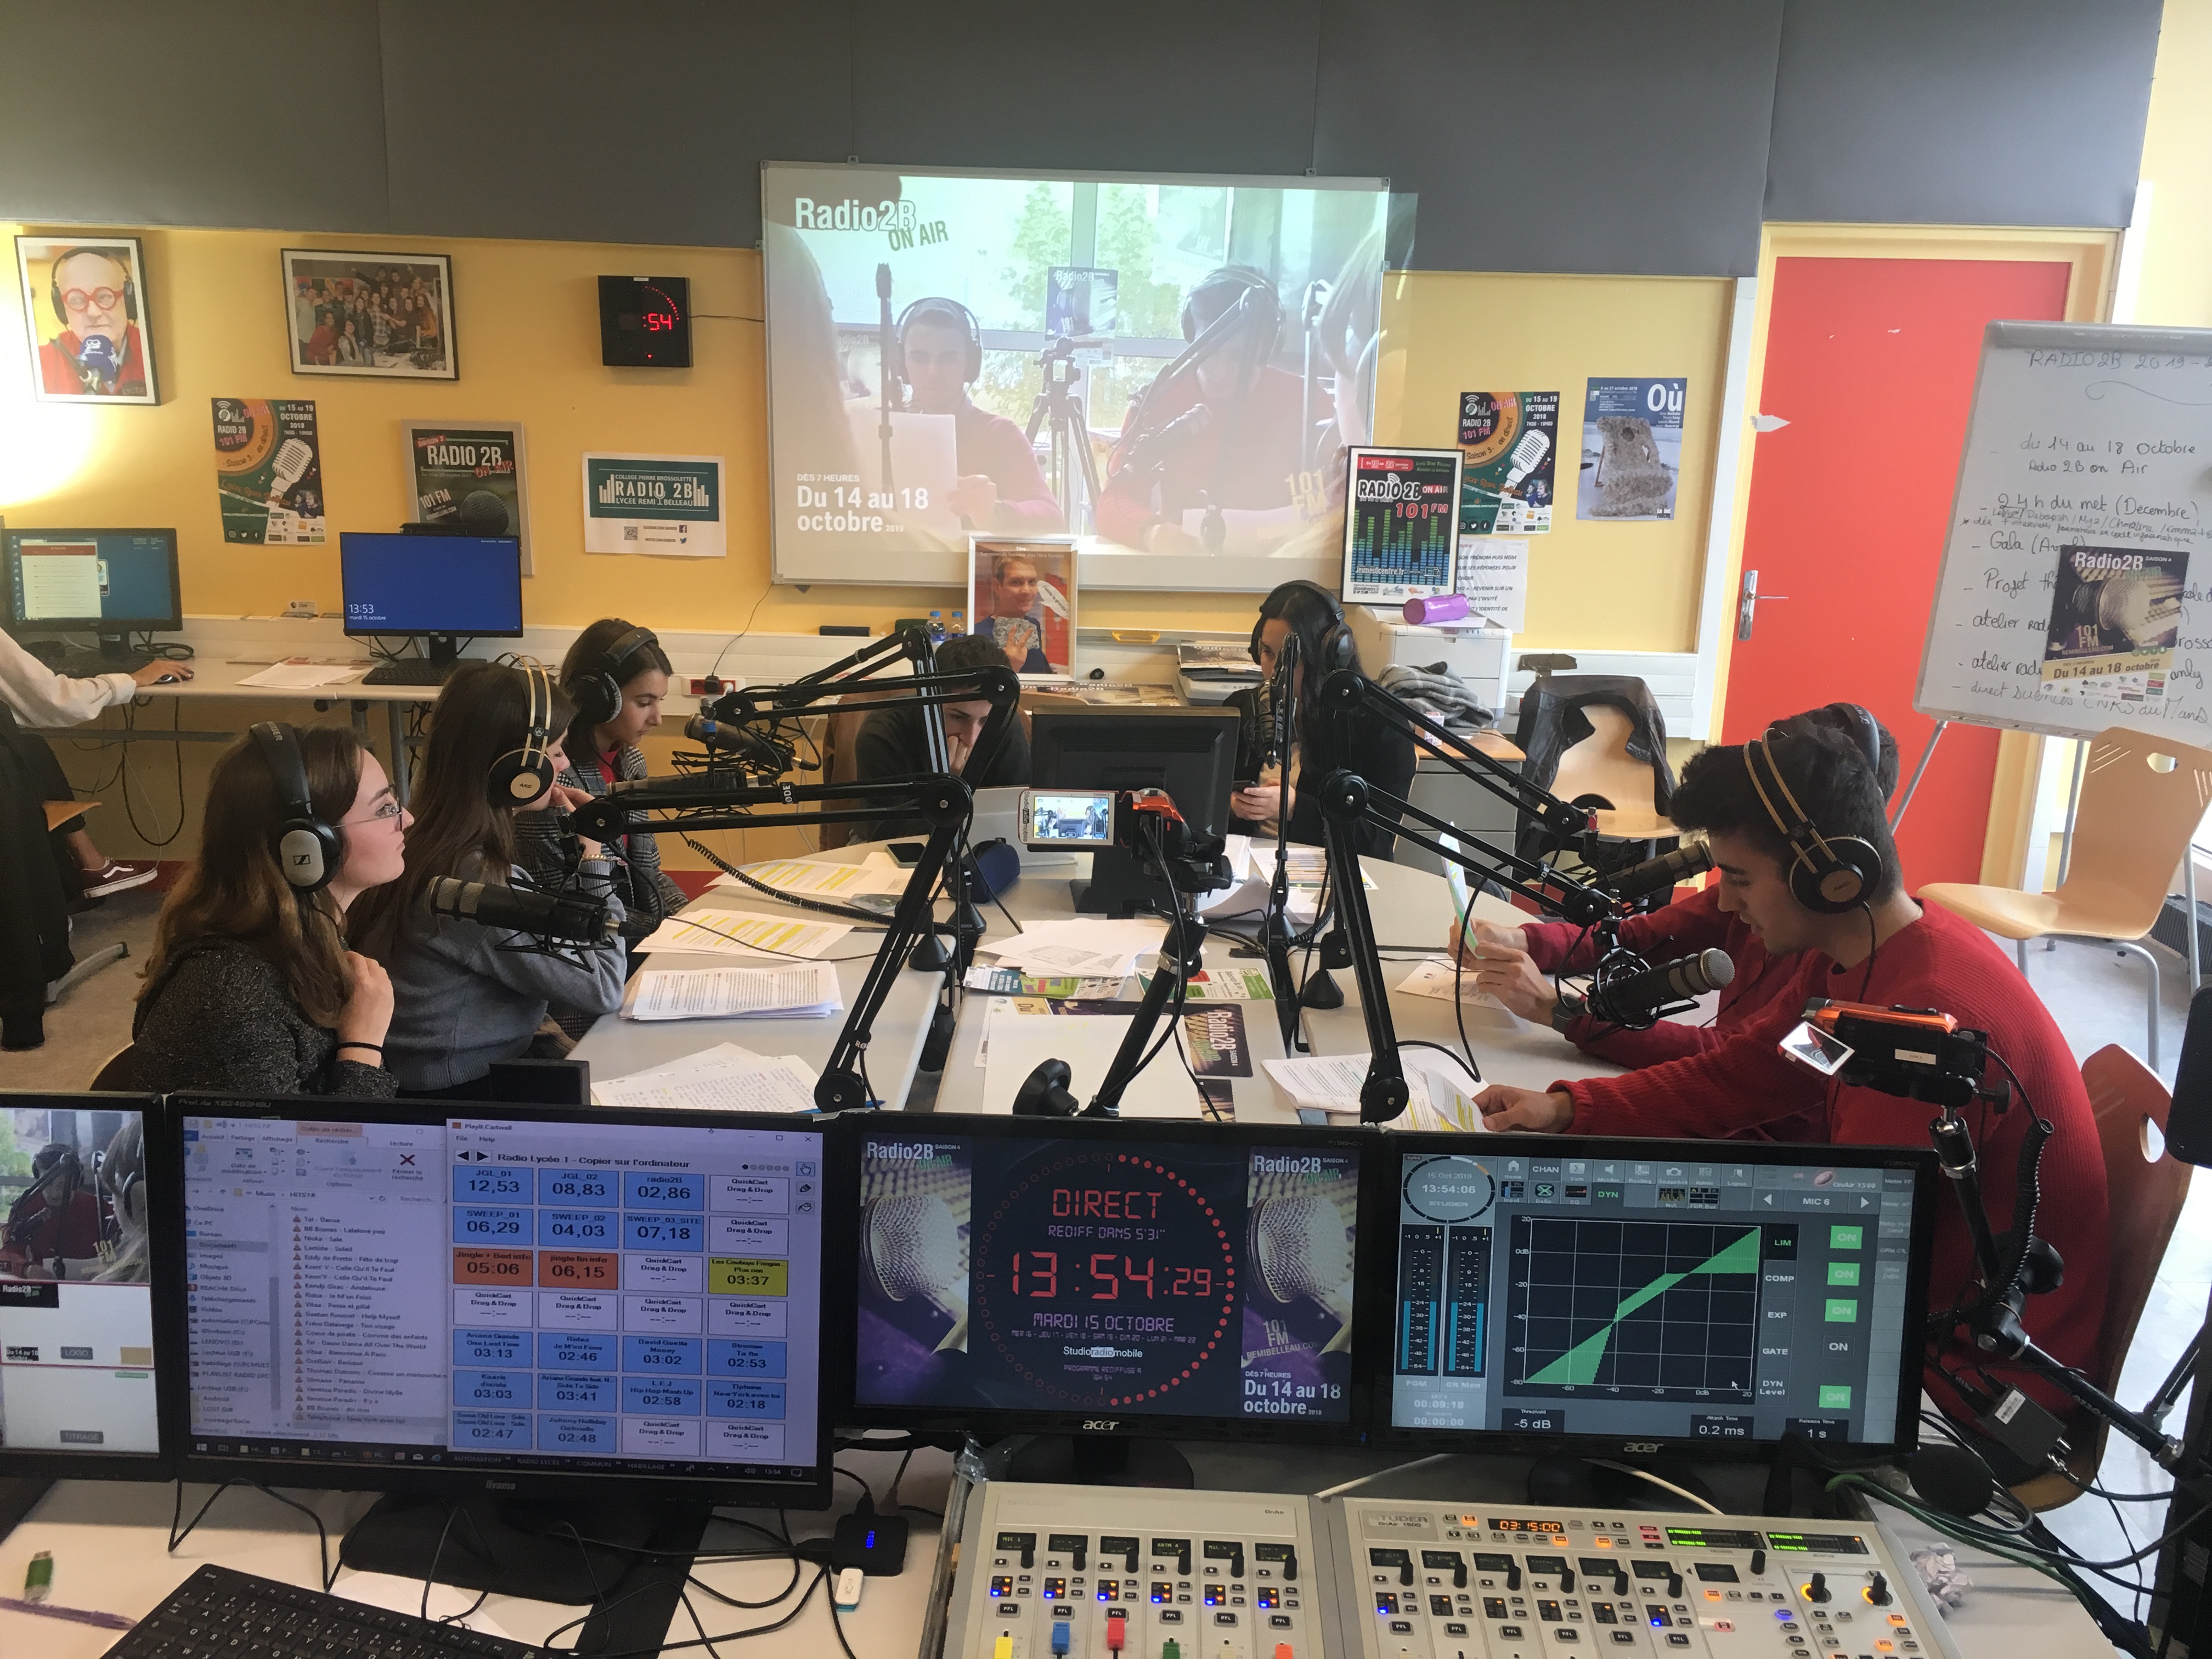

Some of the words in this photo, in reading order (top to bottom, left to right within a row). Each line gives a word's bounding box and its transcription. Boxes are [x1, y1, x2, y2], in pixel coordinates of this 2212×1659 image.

[795, 198, 916, 231] Radio2B
[888, 227, 914, 251] ON
[919, 220, 949, 246] AIR
[1647, 383, 1683, 411] Où
[1491, 400, 1502, 411] ON
[217, 425, 236, 433] RADIO
[1463, 429, 1476, 439] 101
[1479, 427, 1491, 437] FM
[2021, 432, 2040, 450] du
[2047, 436, 2069, 451] 14
[2076, 442, 2095, 452] au
[2108, 441, 2124, 455] 18
[2136, 440, 2196, 456] Octobre
[427, 445, 476, 466] RADIO
[481, 447, 501, 466] 2B
[475, 465, 492, 478] ON
[494, 460, 514, 473] AIR
[2063, 460, 2084, 473] 2B
[2090, 465, 2109, 473] on
[2121, 460, 2148, 474] Air
[823, 474, 860, 482] HEURES
[1285, 469, 1324, 495] 101
[616, 481, 665, 499] RADIO
[673, 483, 692, 498] 2B
[1358, 479, 1402, 499] RADIO
[1422, 485, 1431, 493] ON
[1435, 484, 1448, 493] AIR
[420, 493, 436, 509] 101
[435, 489, 452, 504] FM
[798, 486, 827, 507] Du
[834, 487, 861, 508] 14
[868, 492, 894, 509] au
[901, 487, 928, 509] 18
[1293, 490, 1327, 520] FM
[1396, 503, 1428, 519] 101
[1431, 503, 1448, 514] FM
[797, 510, 883, 532] octobre
[1990, 531, 2024, 551] Gala
[2074, 552, 2143, 571] Radio2B
[348, 604, 374, 614] 13:53
[1973, 609, 2021, 629] atelier
[2076, 624, 2098, 637] 101
[2079, 635, 2098, 648] FM
[2053, 668, 2069, 679] Du
[2073, 666, 2086, 676] 14
[2107, 663, 2121, 673] 18
[2125, 662, 2159, 672] octobre
[1207, 1011, 1237, 1052] Radio2B
[867, 1142, 934, 1160] Radio2B
[531, 1155, 560, 1164] Lycée
[579, 1157, 611, 1165] Copier
[1254, 1155, 1321, 1173] Radio2B
[469, 1180, 520, 1194] 12,53
[552, 1183, 605, 1197] 08,83
[637, 1186, 691, 1200] 02,86
[1422, 1184, 1476, 1194] 13:54:06
[1053, 1189, 1163, 1219] DIRECT
[467, 1220, 520, 1235] 06,29
[552, 1223, 605, 1238] 04,03
[637, 1226, 691, 1241] 07,18
[1048, 1225, 1093, 1238] REDIFF
[1098, 1227, 1131, 1240] DANS
[467, 1262, 520, 1275] 05:06
[552, 1265, 605, 1279] 06,15
[727, 1275, 769, 1285] 03:37
[1033, 1313, 1078, 1328] MARDI
[1105, 1316, 1175, 1332] OCTOBRE
[1263, 1319, 1286, 1334] 101
[1268, 1331, 1289, 1347] FM
[1829, 1343, 1848, 1351] ON
[1245, 1379, 1266, 1396] Du
[1272, 1381, 1291, 1397] 14
[1296, 1386, 1316, 1398] au
[1320, 1383, 1341, 1399] 18
[1244, 1398, 1307, 1415] octobre
[1083, 1420, 1119, 1430] acer
[1514, 1419, 1528, 1428] -5
[1532, 1420, 1551, 1429] dB
[1699, 1425, 1720, 1435] 0.2
[1724, 1427, 1745, 1436] ms
[1624, 1442, 1664, 1453] acer
[1500, 1521, 1560, 1532] 03:15:00
